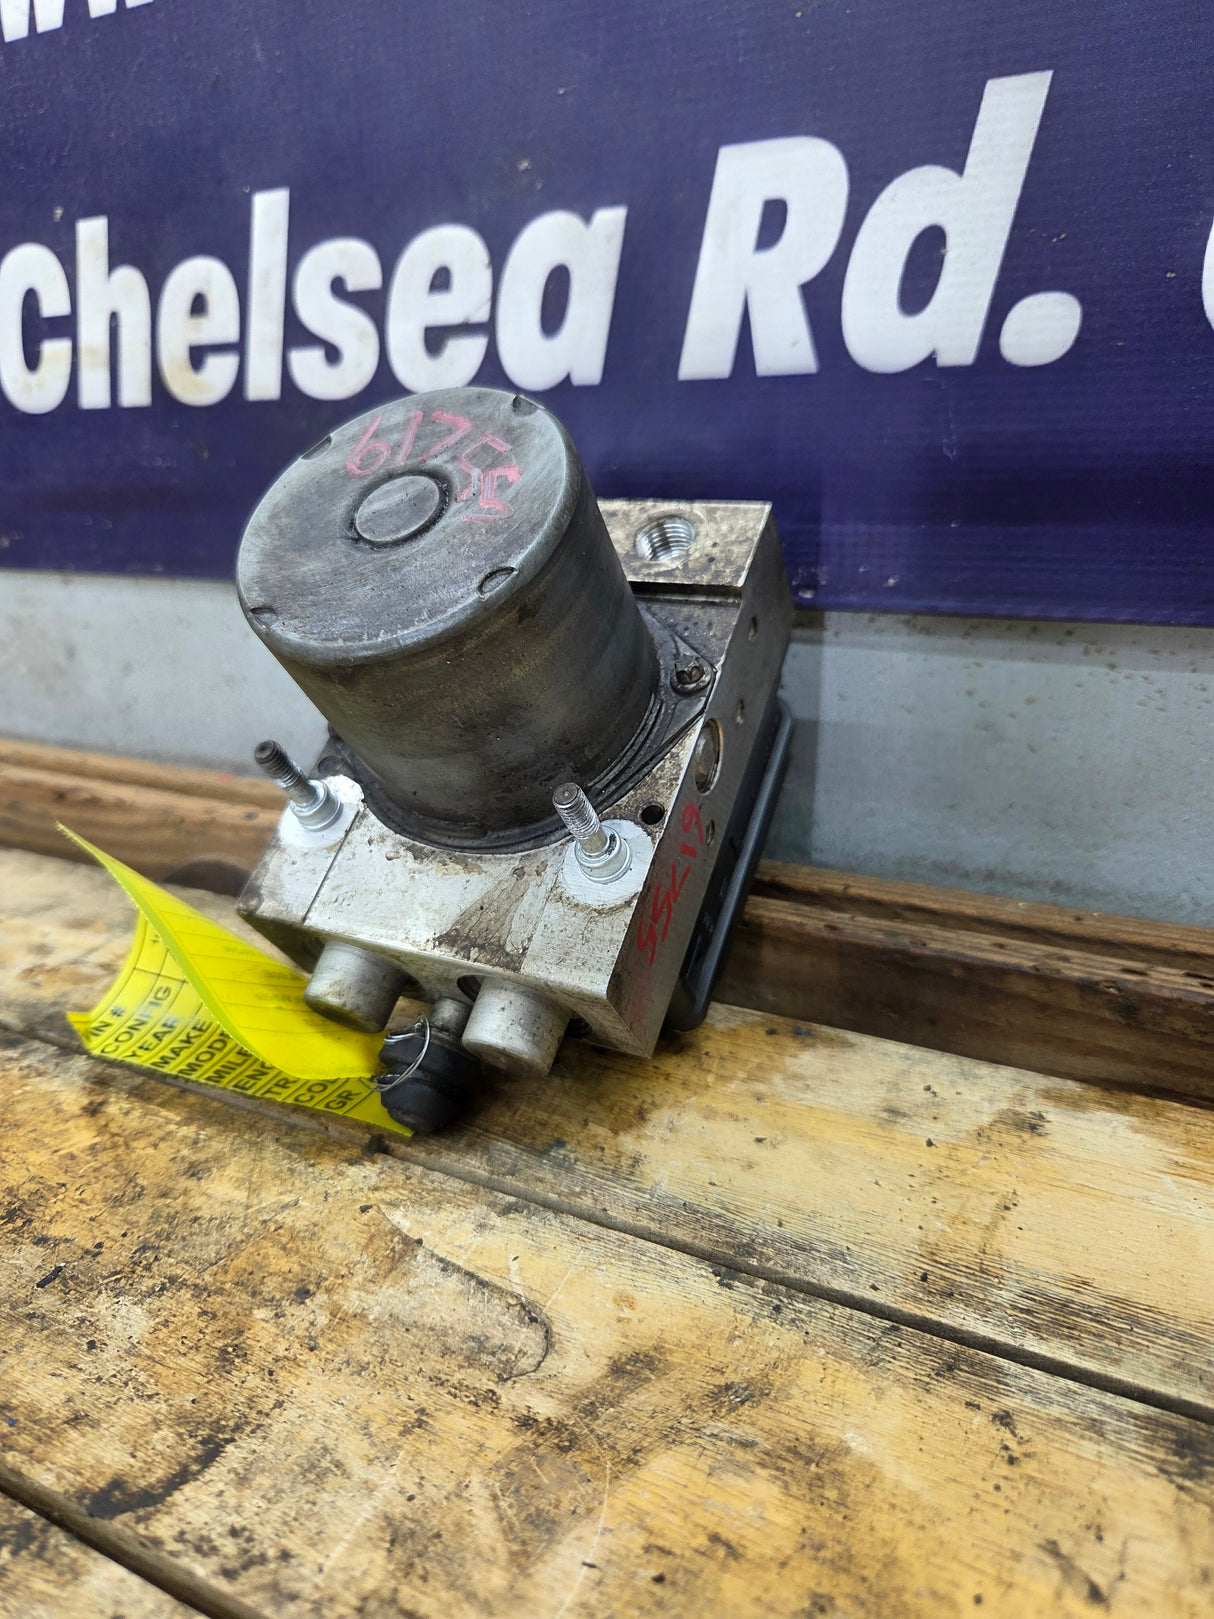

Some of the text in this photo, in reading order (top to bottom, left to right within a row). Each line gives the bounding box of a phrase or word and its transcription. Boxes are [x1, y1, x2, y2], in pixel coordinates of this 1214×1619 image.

[0, 188, 627, 414] Chelsea
[678, 70, 1082, 380] Rd.
[101, 986, 171, 1054] CONFIG
[123, 1016, 178, 1058] YEAR
[150, 1020, 213, 1068] MAKE
